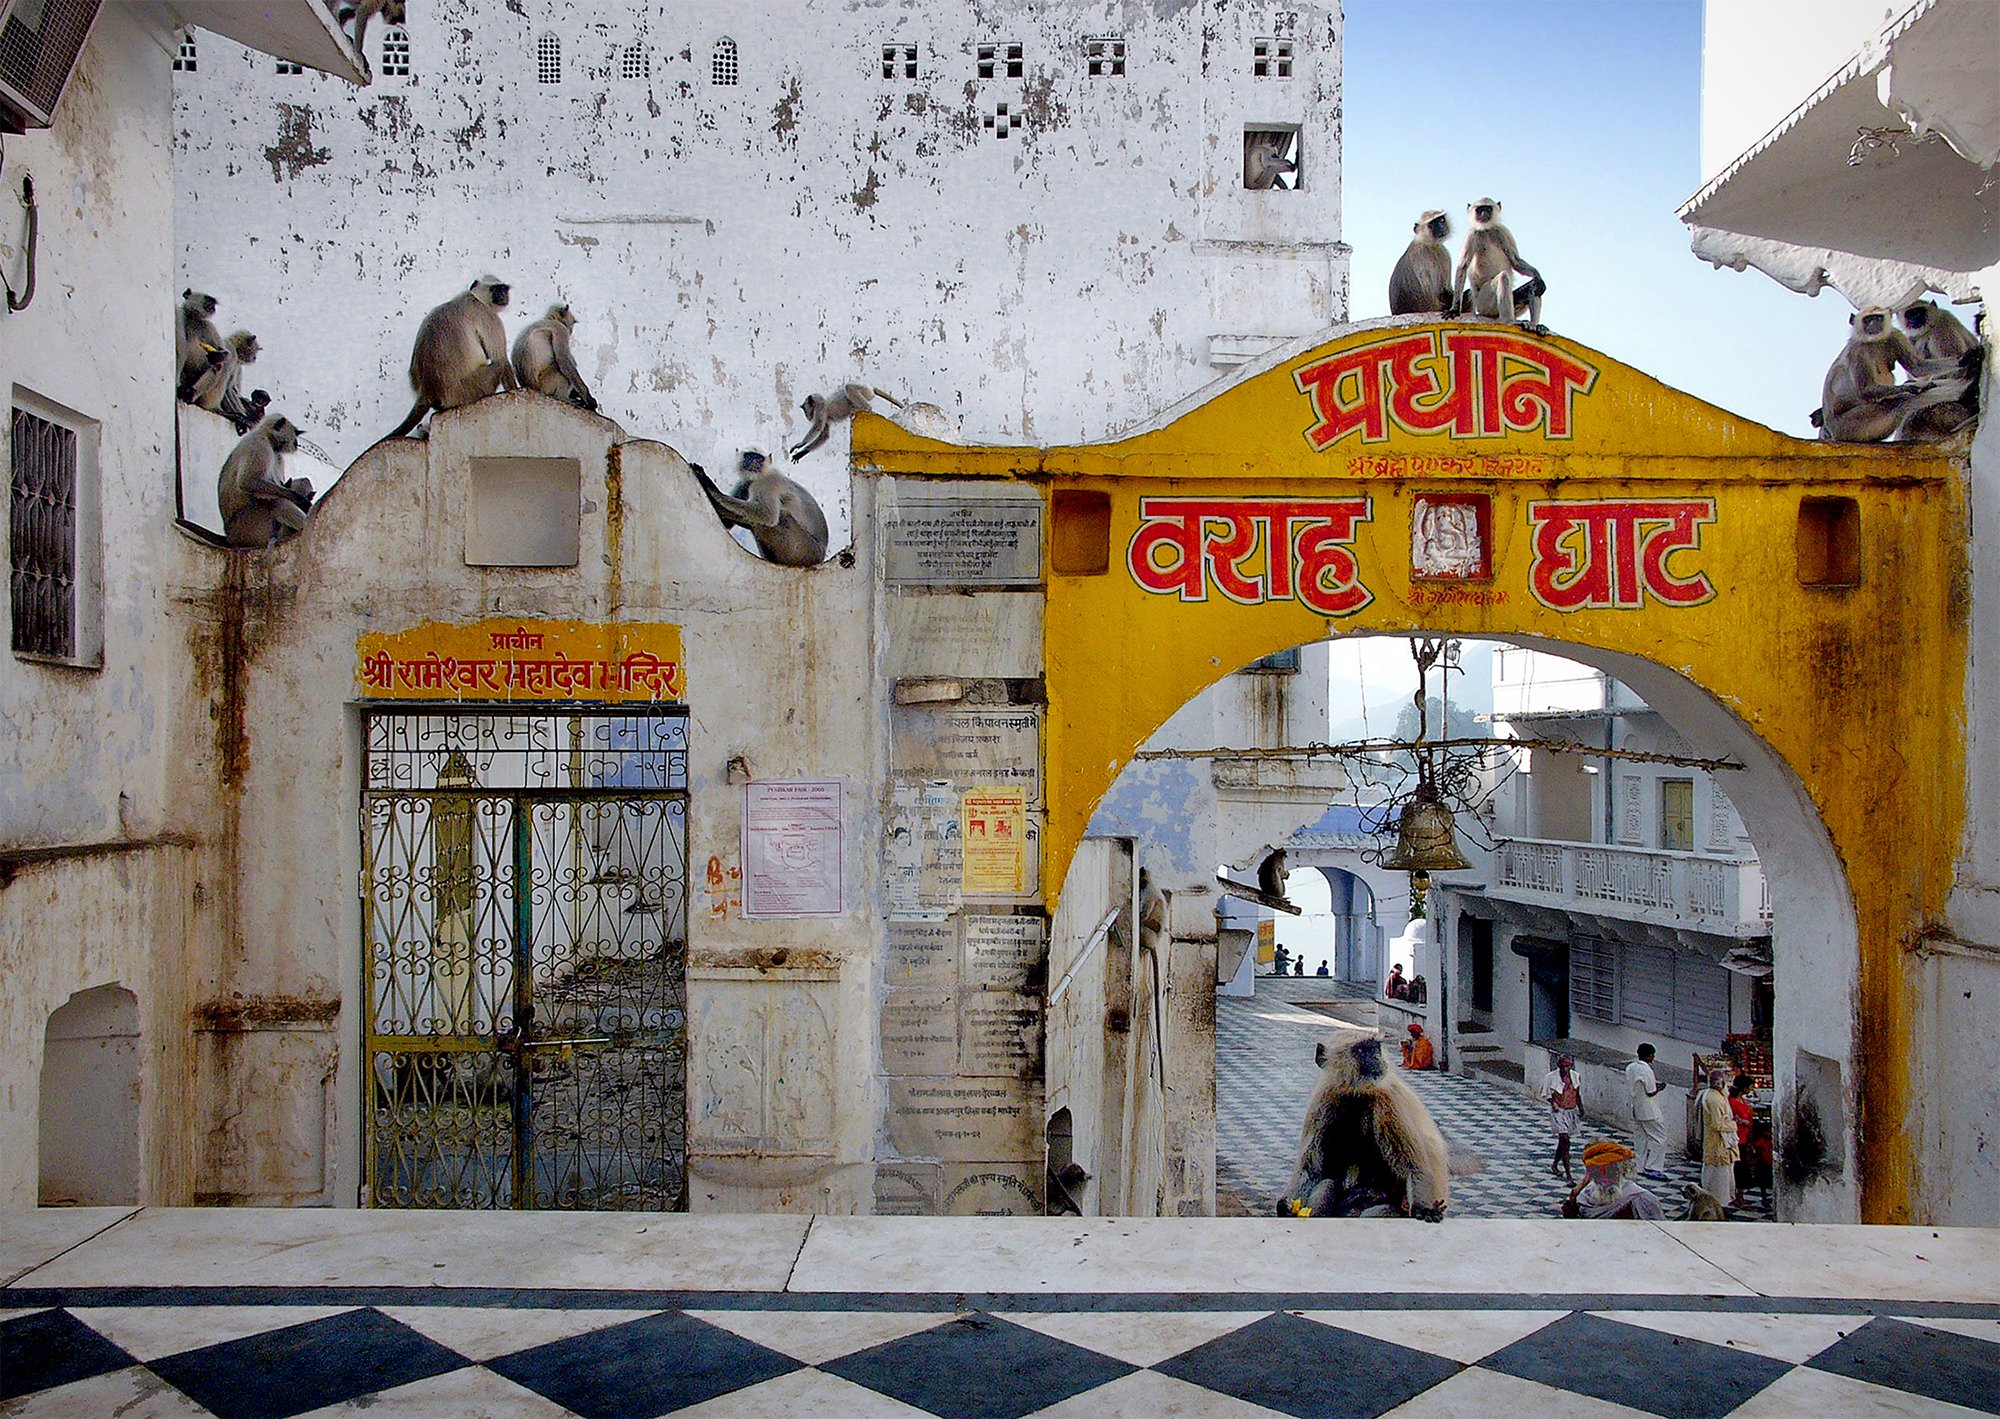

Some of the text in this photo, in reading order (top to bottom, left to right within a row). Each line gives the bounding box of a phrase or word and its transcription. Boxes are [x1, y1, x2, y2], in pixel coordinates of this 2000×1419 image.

[1292, 330, 1600, 452] प्रधान
[1126, 496, 1717, 617] वराह घाट
[362, 650, 679, 699] श्री रामेश्वर महादेव मन्दिर
[490, 626, 544, 650] प्राचीन
